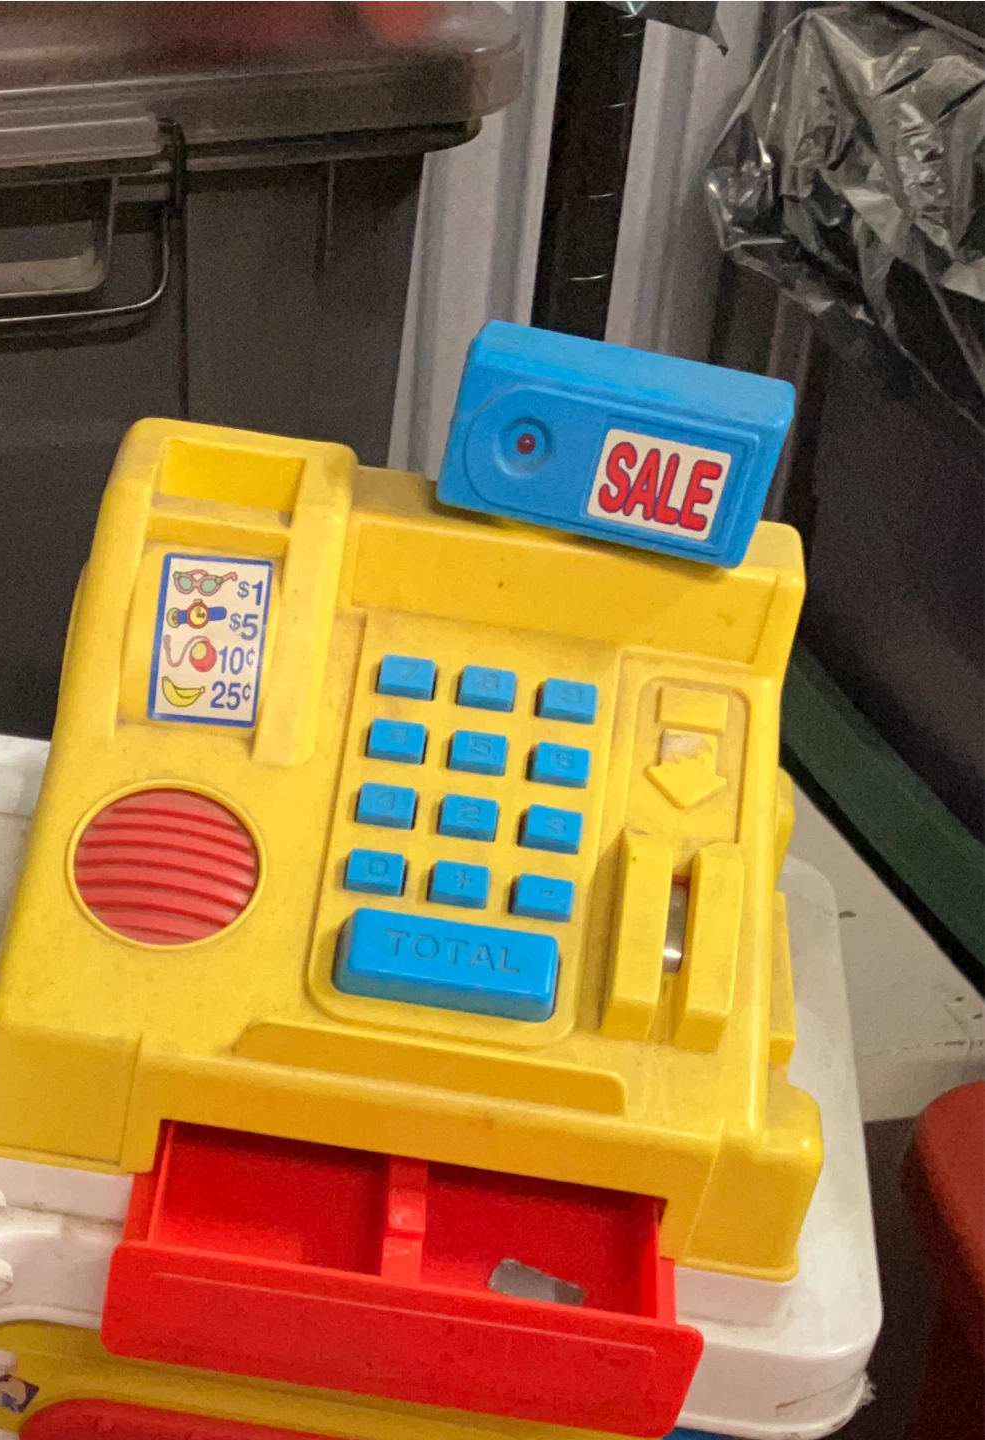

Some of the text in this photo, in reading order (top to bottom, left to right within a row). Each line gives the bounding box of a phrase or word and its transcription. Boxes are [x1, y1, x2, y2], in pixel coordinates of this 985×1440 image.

[598, 441, 722, 532] SALE
[237, 580, 264, 606] $1
[229, 612, 259, 641] $5
[218, 645, 255, 675] 10¢
[210, 680, 251, 710] 25¢
[400, 661, 583, 703] 7 8 9
[390, 726, 575, 771] 4 5 6
[456, 803, 482, 823] 2
[545, 814, 566, 834] 3
[384, 929, 520, 974] TOTAL
